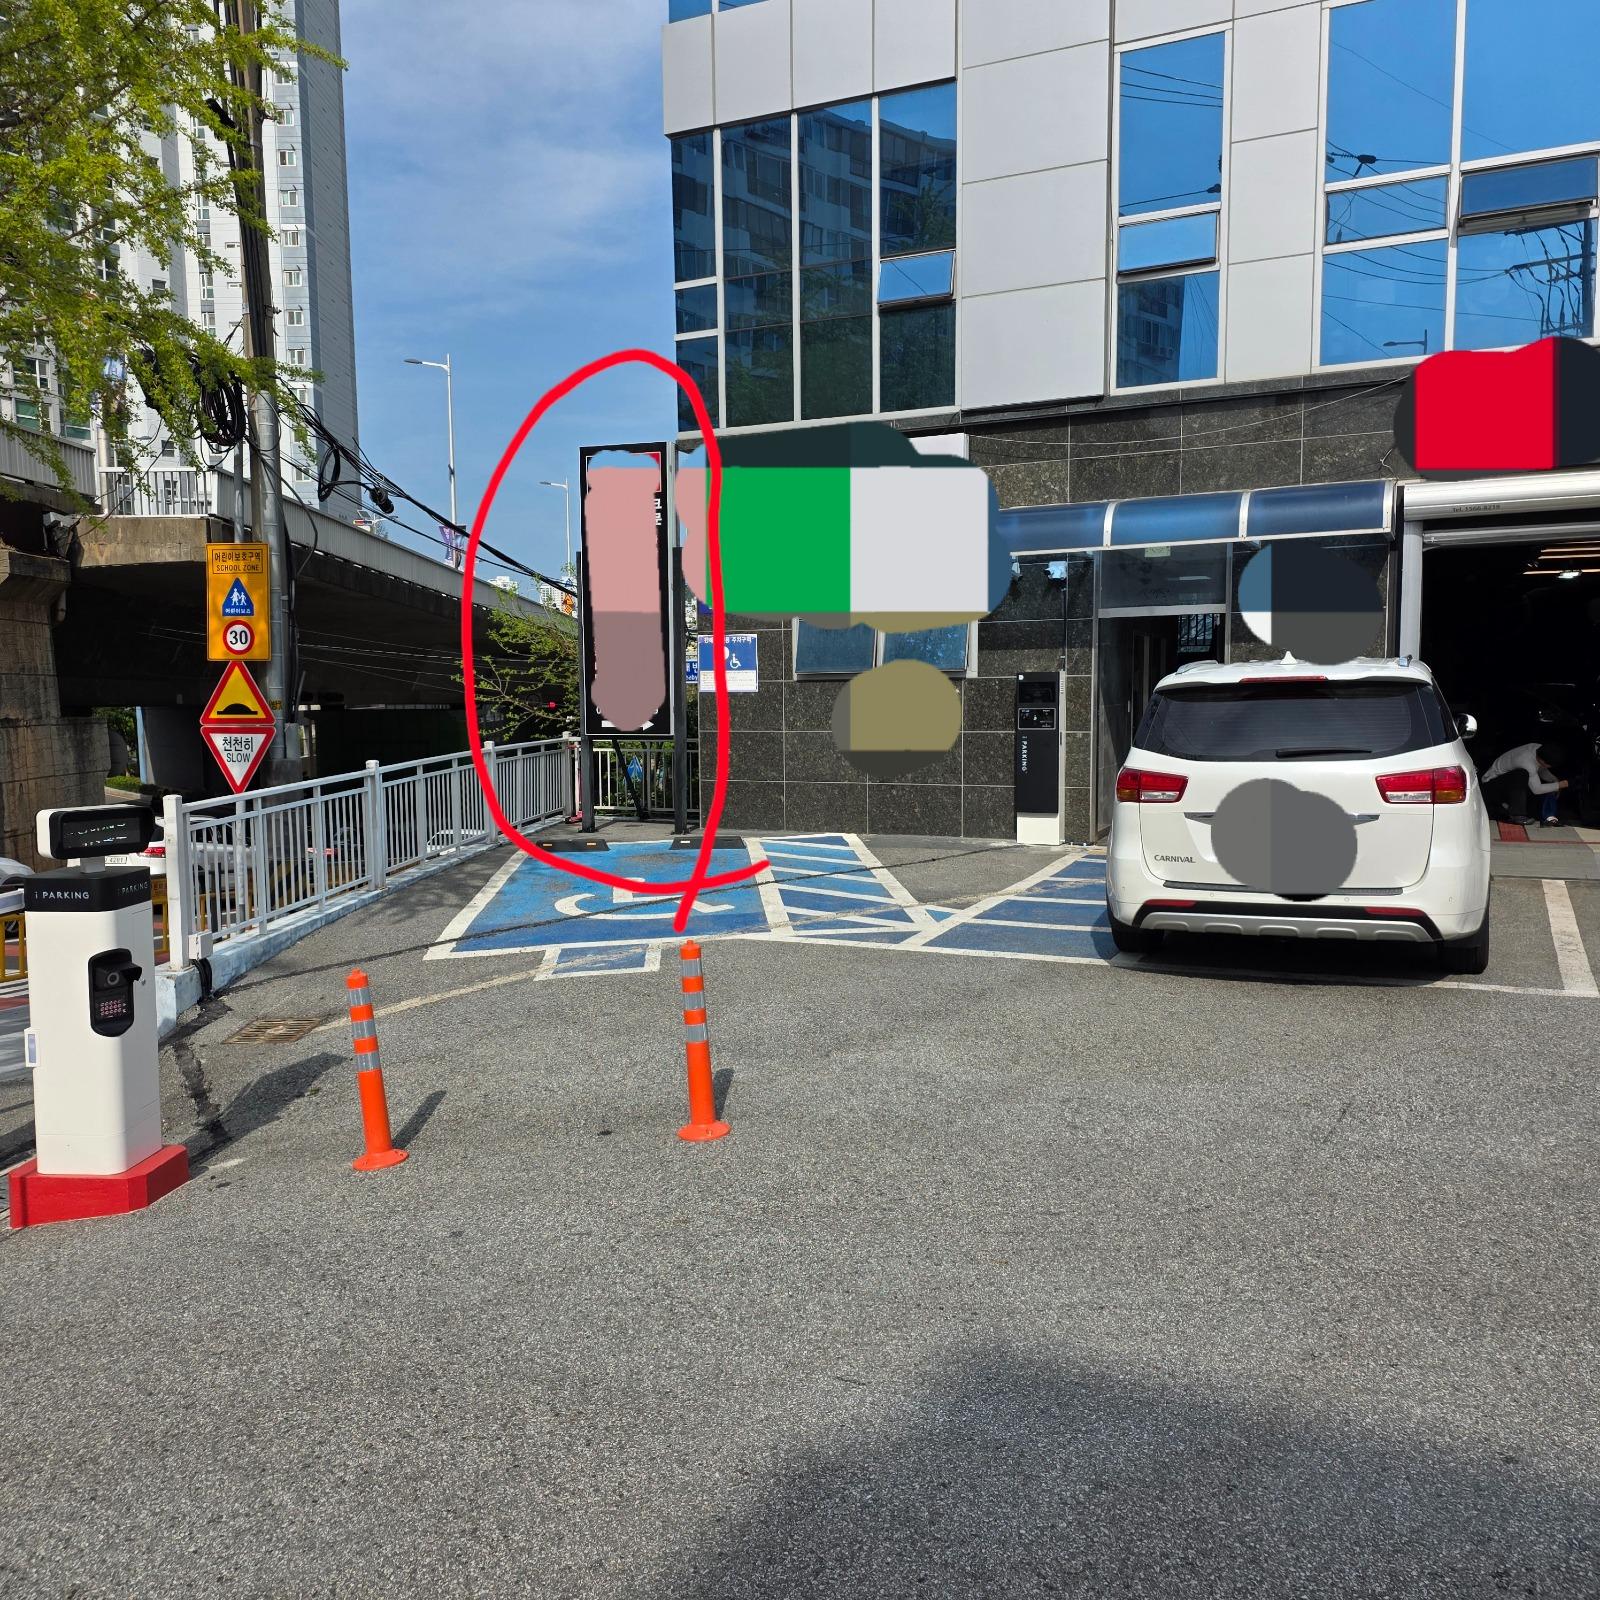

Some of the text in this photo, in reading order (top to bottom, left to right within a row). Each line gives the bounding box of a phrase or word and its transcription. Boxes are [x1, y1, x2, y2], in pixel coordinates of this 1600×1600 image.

[214, 551, 261, 562] 어린이보호구역
[216, 564, 241, 572] SCHOOL
[229, 630, 248, 645] 30
[222, 736, 254, 752] 천천히
[226, 752, 251, 763] SLOW
[1154, 853, 1196, 864] CARNIVAL
[122, 881, 148, 895] PARKING
[42, 891, 90, 900] PARKING
